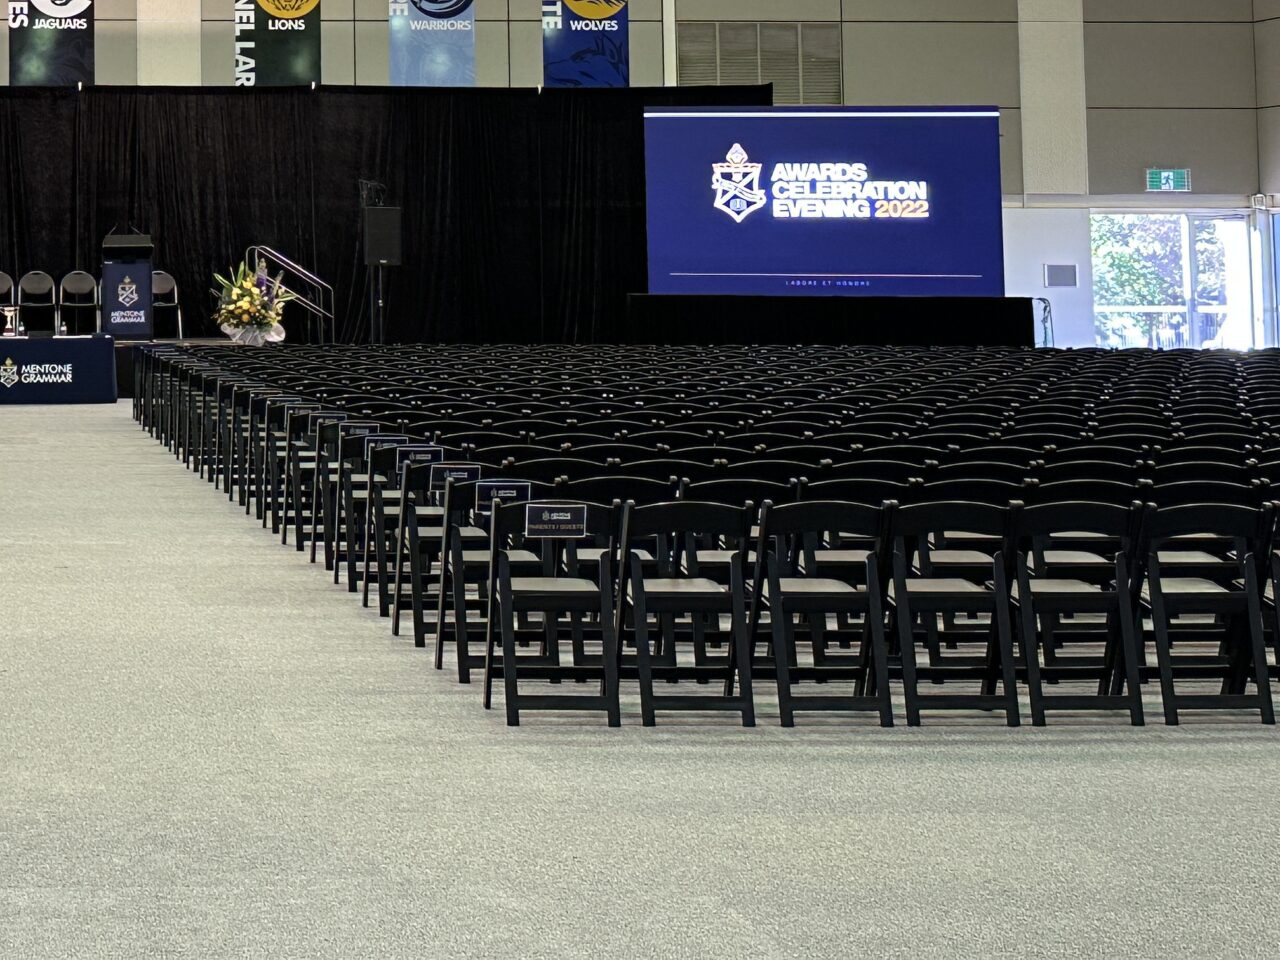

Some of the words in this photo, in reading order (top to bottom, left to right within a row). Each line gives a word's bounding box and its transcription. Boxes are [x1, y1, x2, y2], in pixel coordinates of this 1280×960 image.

[33, 18, 87, 30] JAGUARS
[268, 19, 306, 31] LIONS
[410, 20, 471, 31] WARRIORS
[570, 20, 618, 31] WOLVES
[771, 163, 867, 182] AWARDS
[772, 181, 927, 200] CELEBRATION
[773, 200, 871, 218] EVENING
[875, 201, 929, 218] 2022
[20, 364, 73, 374] MENTONE
[20, 373, 73, 384] GRAMMAR
